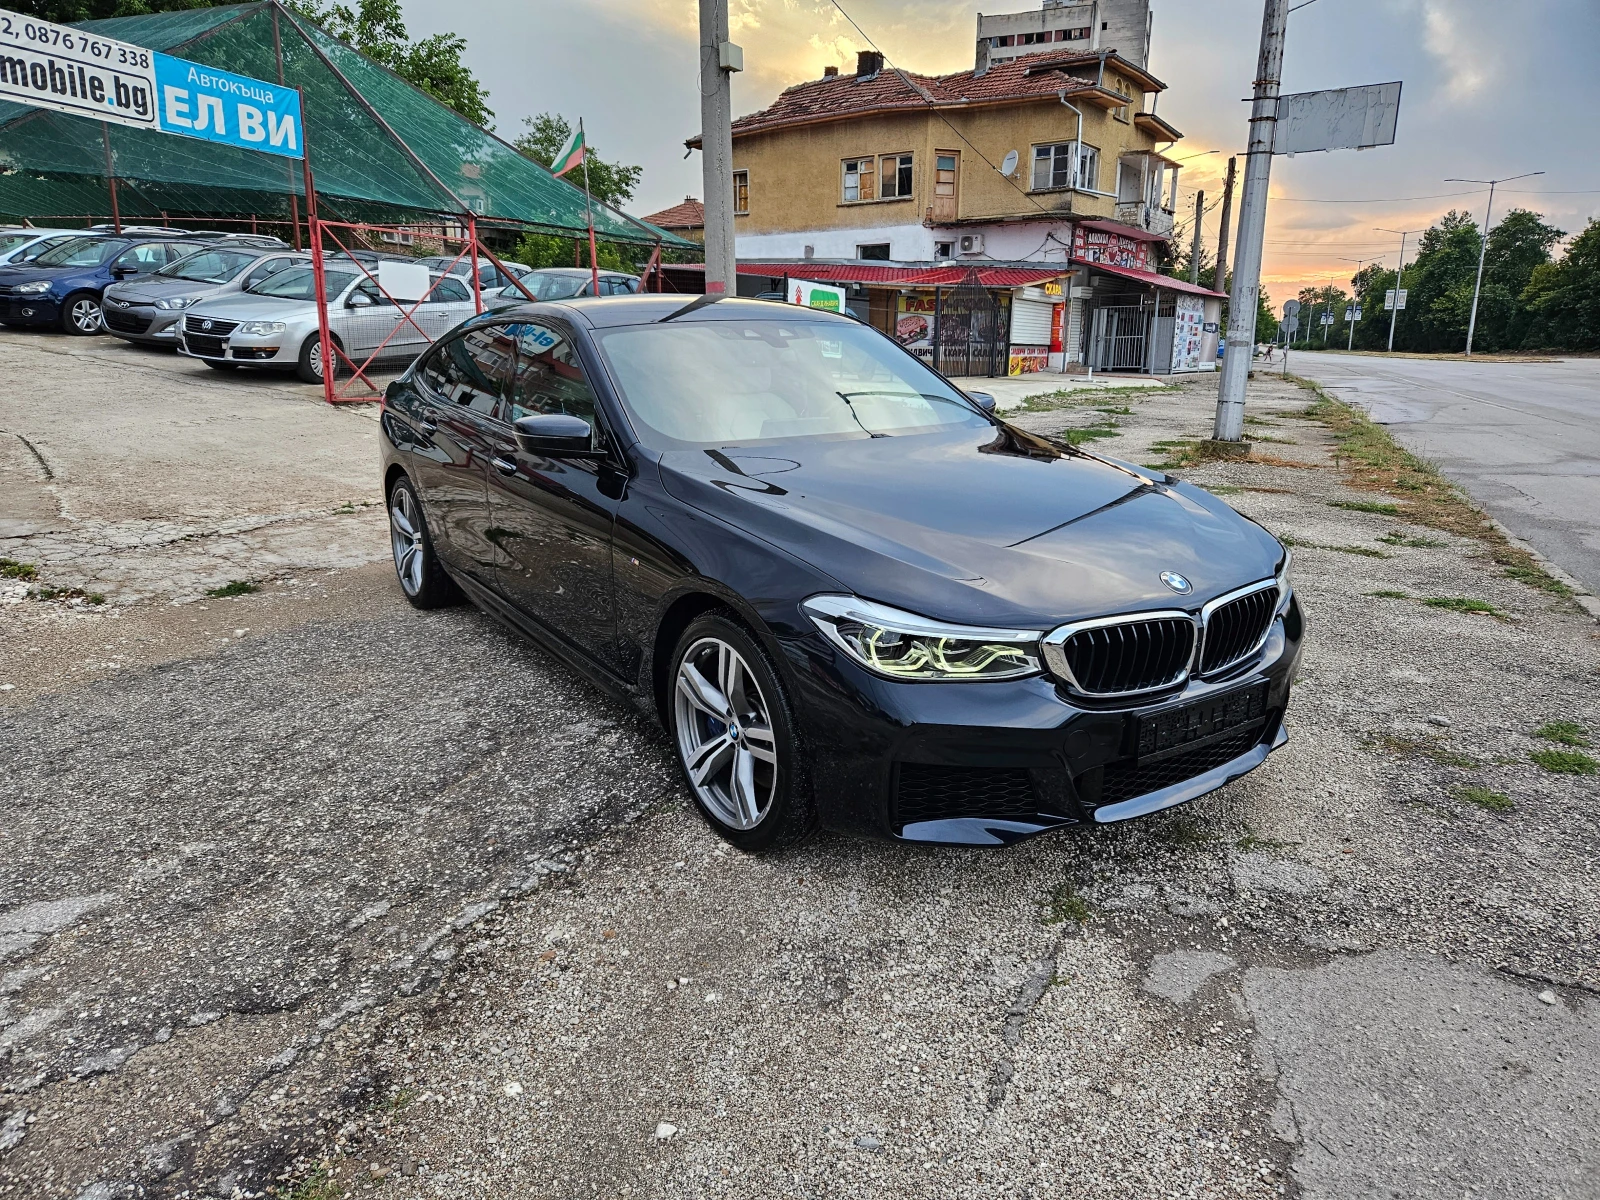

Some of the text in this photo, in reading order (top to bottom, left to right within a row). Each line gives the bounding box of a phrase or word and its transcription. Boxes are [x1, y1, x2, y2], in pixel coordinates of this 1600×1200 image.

[25, 23, 75, 50] 0876
[78, 36, 112, 60] 767
[118, 48, 150, 69] 338
[0, 54, 149, 117] mobile.bg
[187, 66, 274, 104] Автокъща
[163, 84, 297, 150] ЕЛ ВИ
[1045, 282, 1062, 296] СКАРА
